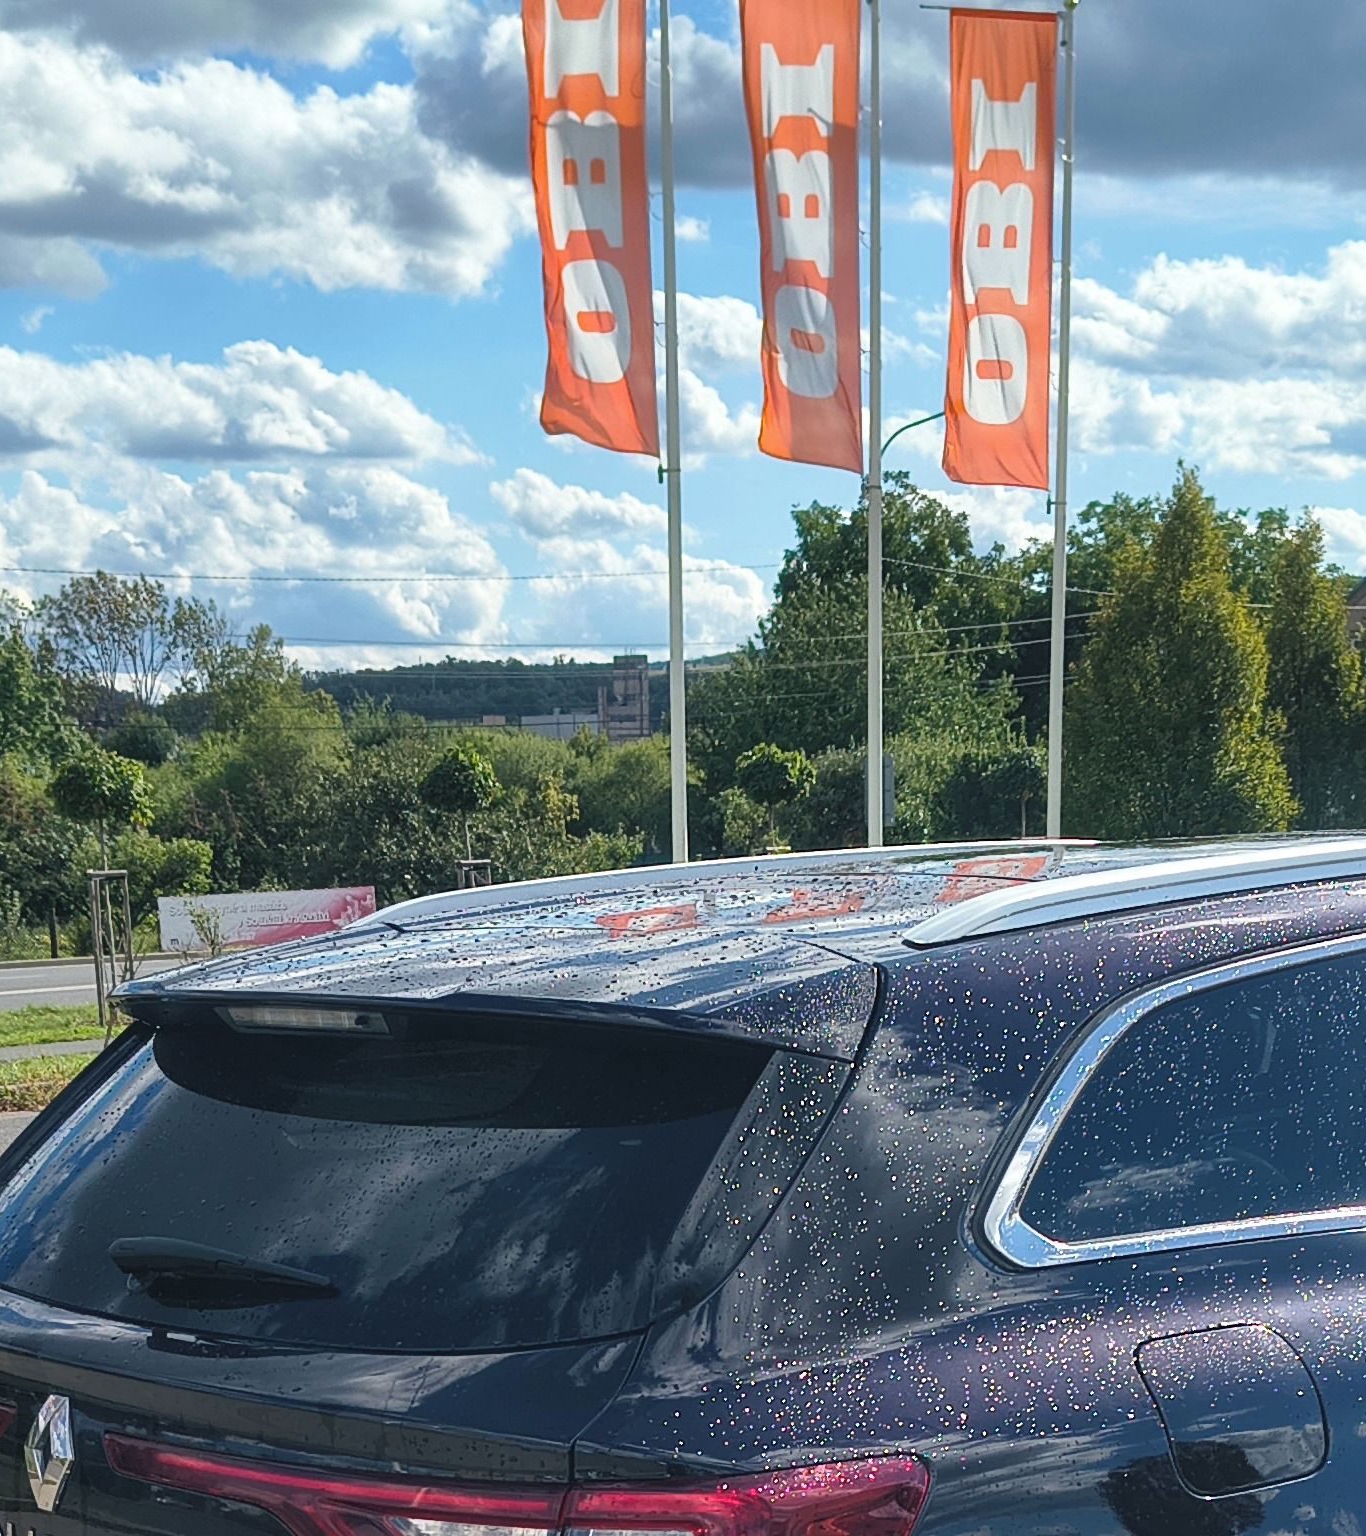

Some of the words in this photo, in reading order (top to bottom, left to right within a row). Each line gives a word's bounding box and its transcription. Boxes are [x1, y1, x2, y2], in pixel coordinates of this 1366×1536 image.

[544, 0, 632, 384] OBI
[760, 43, 837, 399] OBI
[961, 78, 1037, 426] OBI
